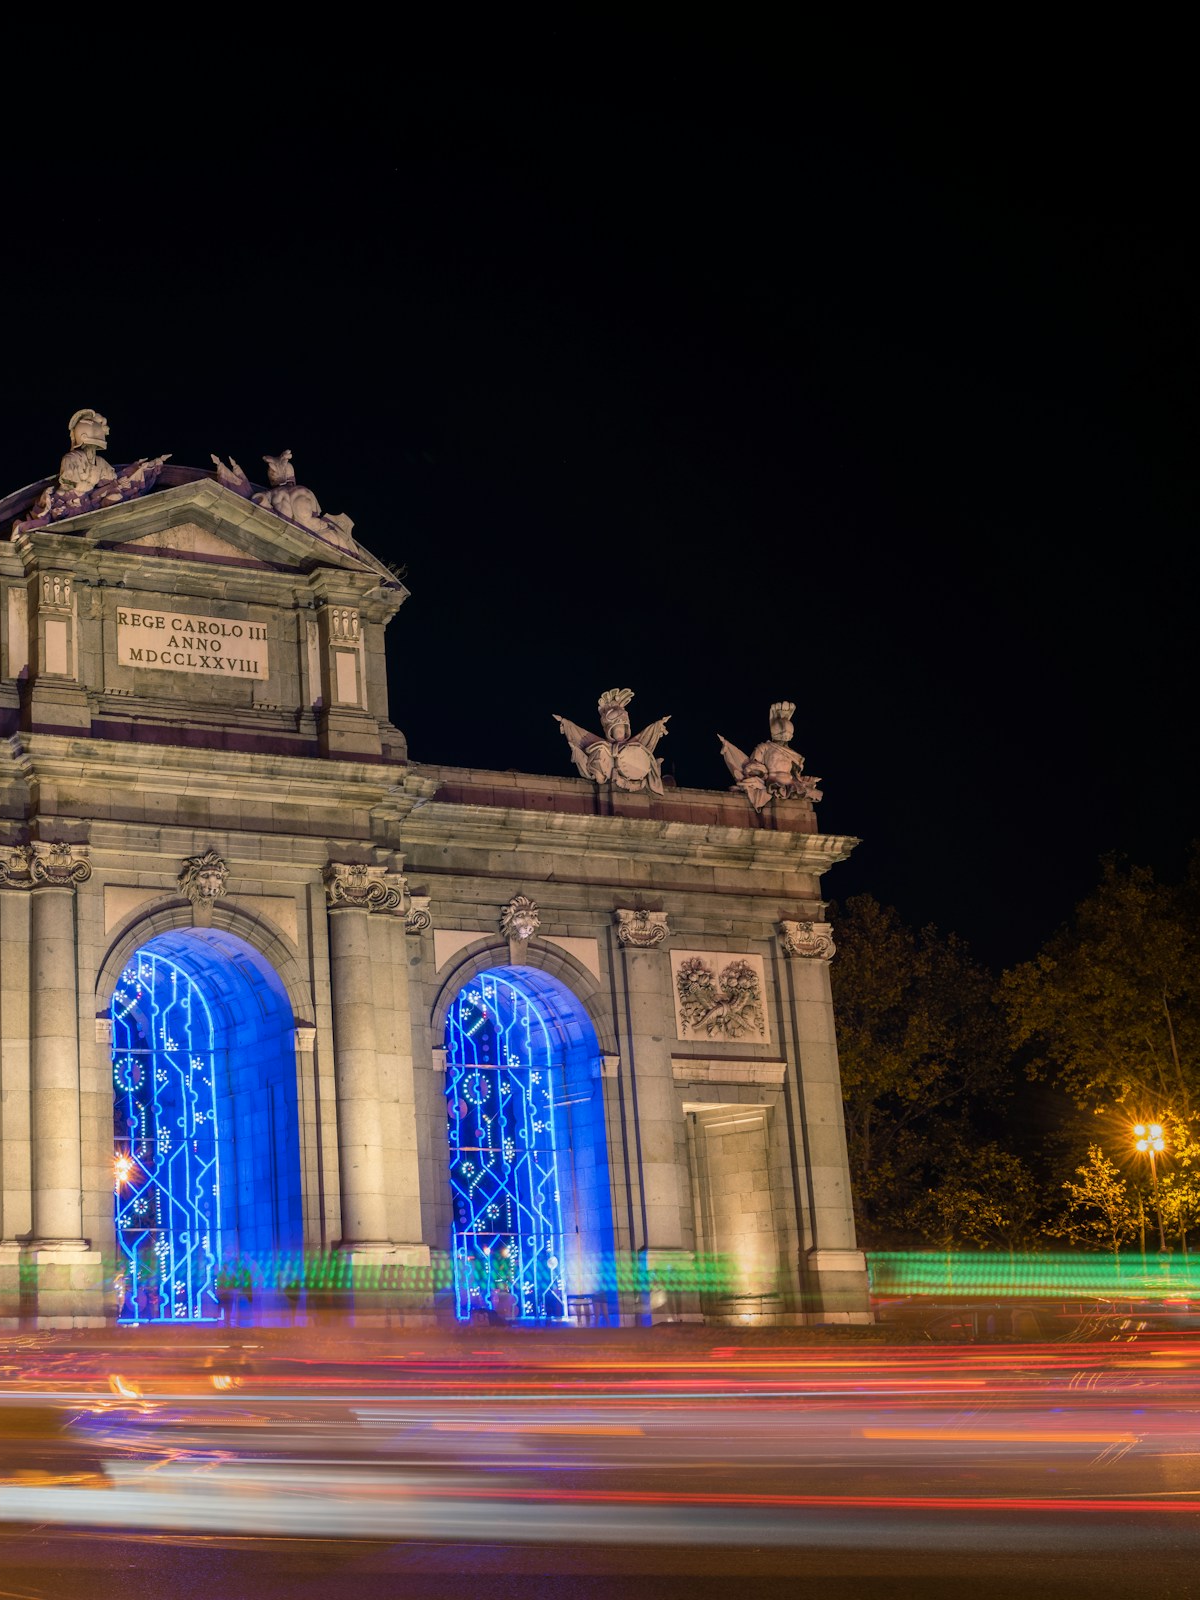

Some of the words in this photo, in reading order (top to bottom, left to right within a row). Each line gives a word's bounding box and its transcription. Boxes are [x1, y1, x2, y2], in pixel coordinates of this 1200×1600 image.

[117, 612, 165, 630] REGE
[171, 618, 243, 638] CAROLO
[248, 626, 268, 641] III
[167, 635, 222, 652] ANNO
[129, 647, 259, 674] MDCCLXXVIII
